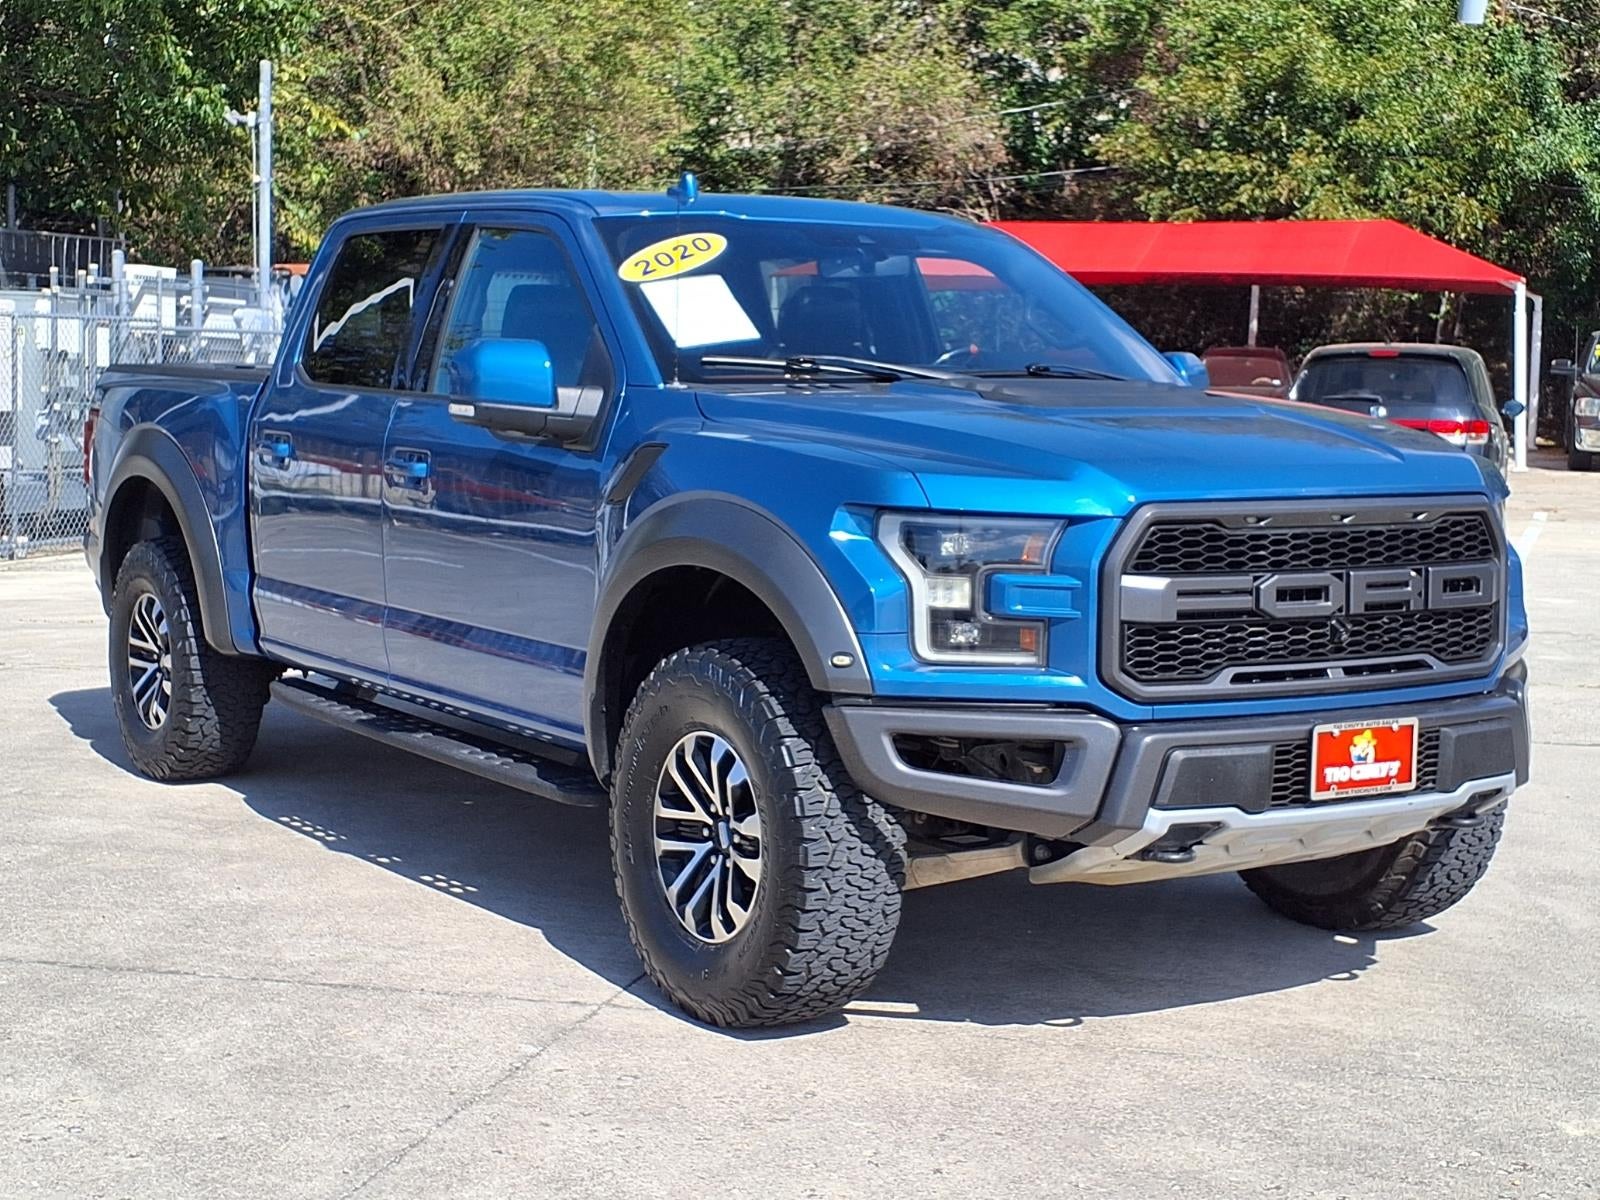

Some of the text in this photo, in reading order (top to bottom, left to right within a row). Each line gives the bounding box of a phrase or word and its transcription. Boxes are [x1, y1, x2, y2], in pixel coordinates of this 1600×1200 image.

[634, 237, 712, 277] 2020
[1121, 561, 1499, 622] FORD
[1324, 765, 1350, 784] TIO
